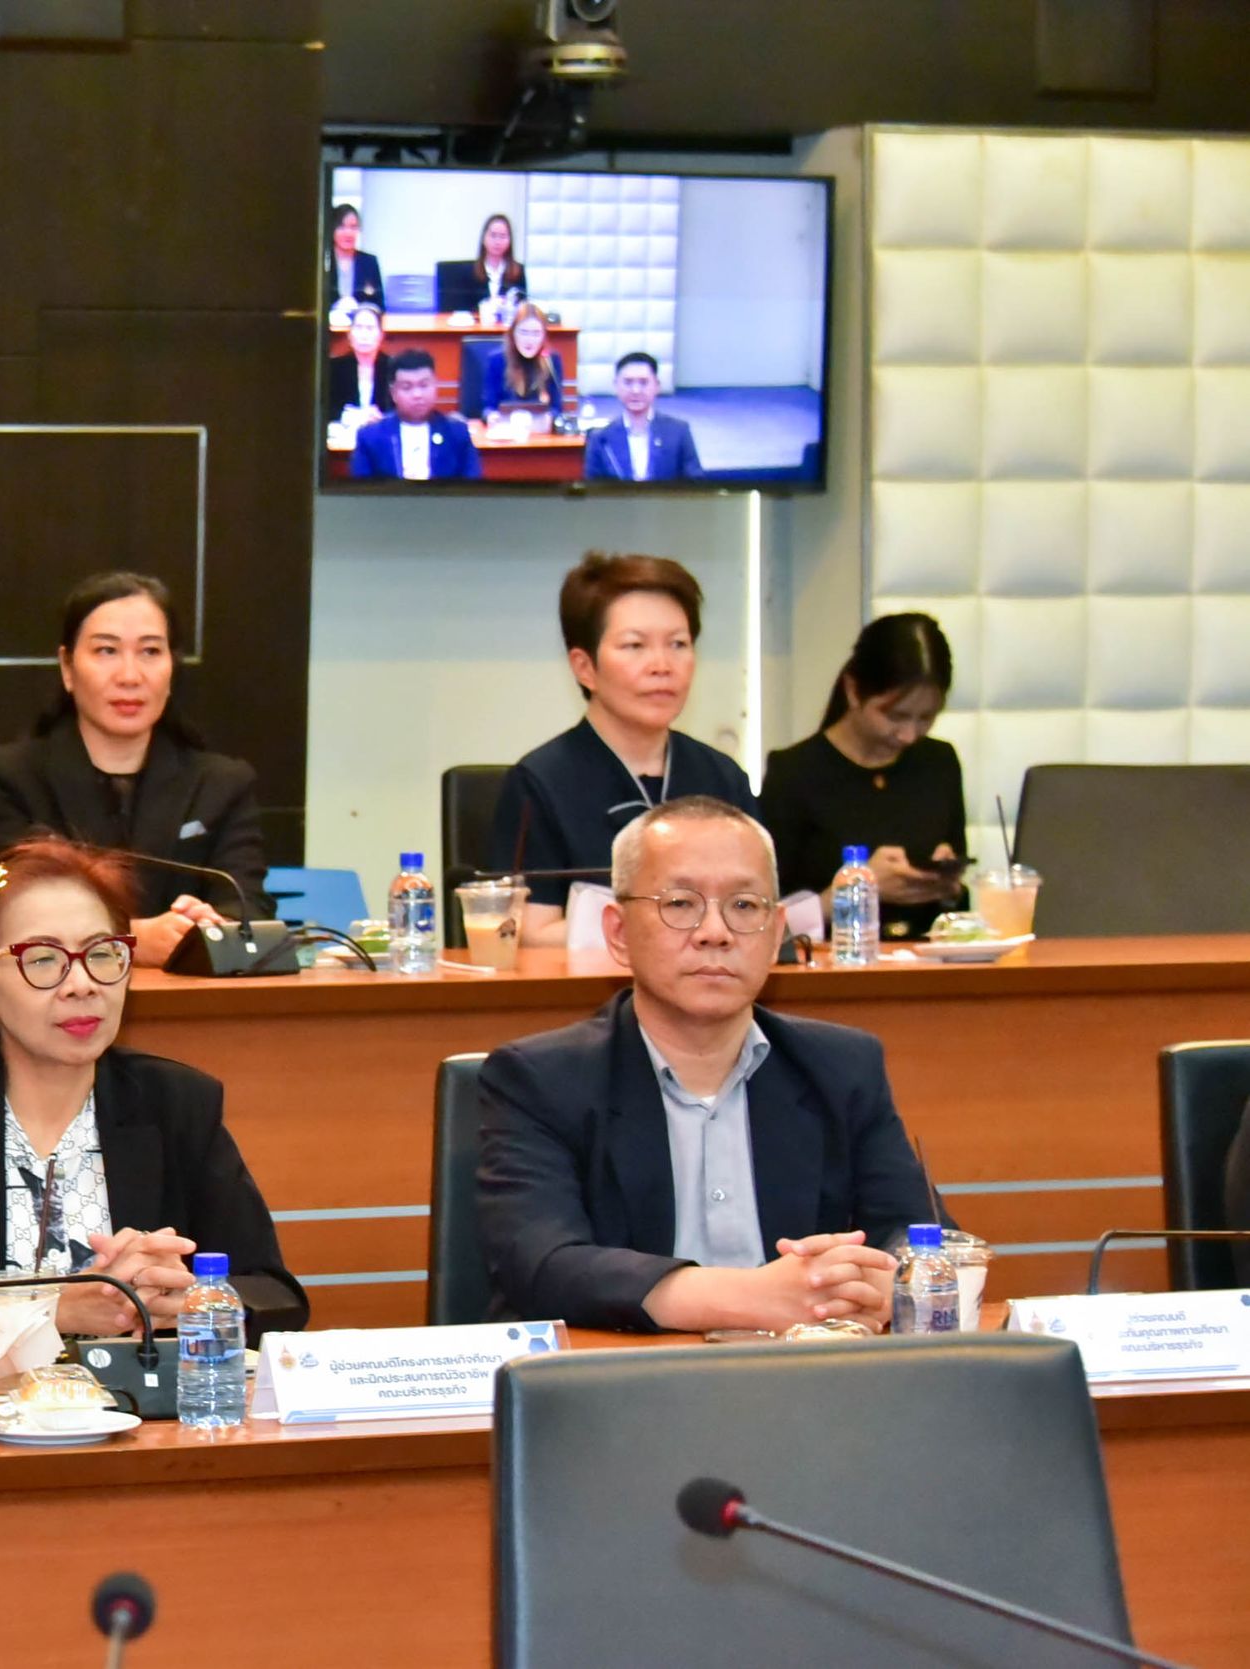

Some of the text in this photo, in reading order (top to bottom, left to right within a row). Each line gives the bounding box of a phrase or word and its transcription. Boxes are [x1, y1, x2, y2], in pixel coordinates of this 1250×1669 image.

[378, 1384, 468, 1398] คณะบริหารธุรกิจ
